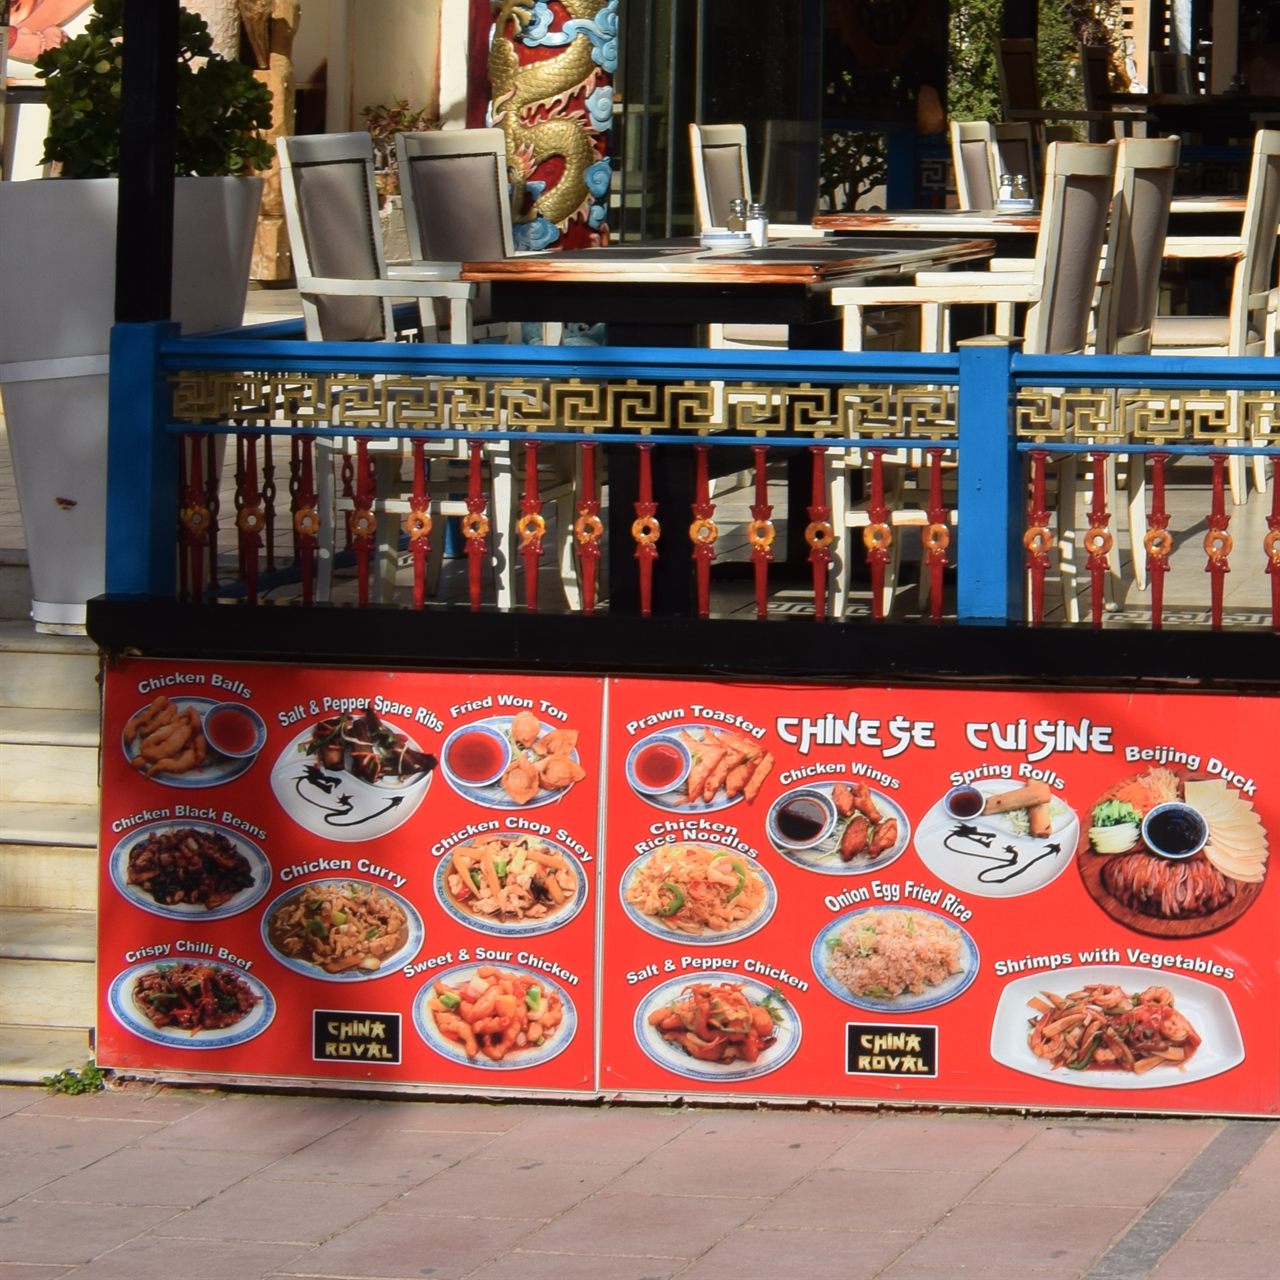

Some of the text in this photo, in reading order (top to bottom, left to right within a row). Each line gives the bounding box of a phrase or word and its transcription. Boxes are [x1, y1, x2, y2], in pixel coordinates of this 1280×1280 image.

[138, 672, 251, 698] Chicken Balls
[279, 696, 443, 731] Salt & Pepper Spare Ribs
[450, 695, 567, 721] Fried Won Ton
[626, 706, 766, 740] Prawn Toasted
[778, 712, 1115, 762] CHINESE CUISINE
[780, 762, 901, 790] Chicken Wings
[950, 762, 1065, 792] Spring Rolls
[1125, 745, 1258, 797] Beijing Duck
[112, 805, 267, 840] Chicken Black Beans
[650, 819, 737, 840] Chicken
[431, 817, 593, 864] Chicken Chop Suey
[634, 829, 759, 860] Rice Noodles
[281, 858, 407, 888] Chicken Curry
[825, 881, 973, 924] Onion Egg Fried Rice
[125, 941, 253, 971] Crispy Chilli Beef
[403, 948, 579, 985] Sweet & Sour Chicken
[994, 948, 1235, 980] Shrimps with Vegetables
[626, 955, 809, 993] Salt Pepper Chicken
[328, 1020, 386, 1041] CHINA
[861, 1034, 921, 1053] CHINA
